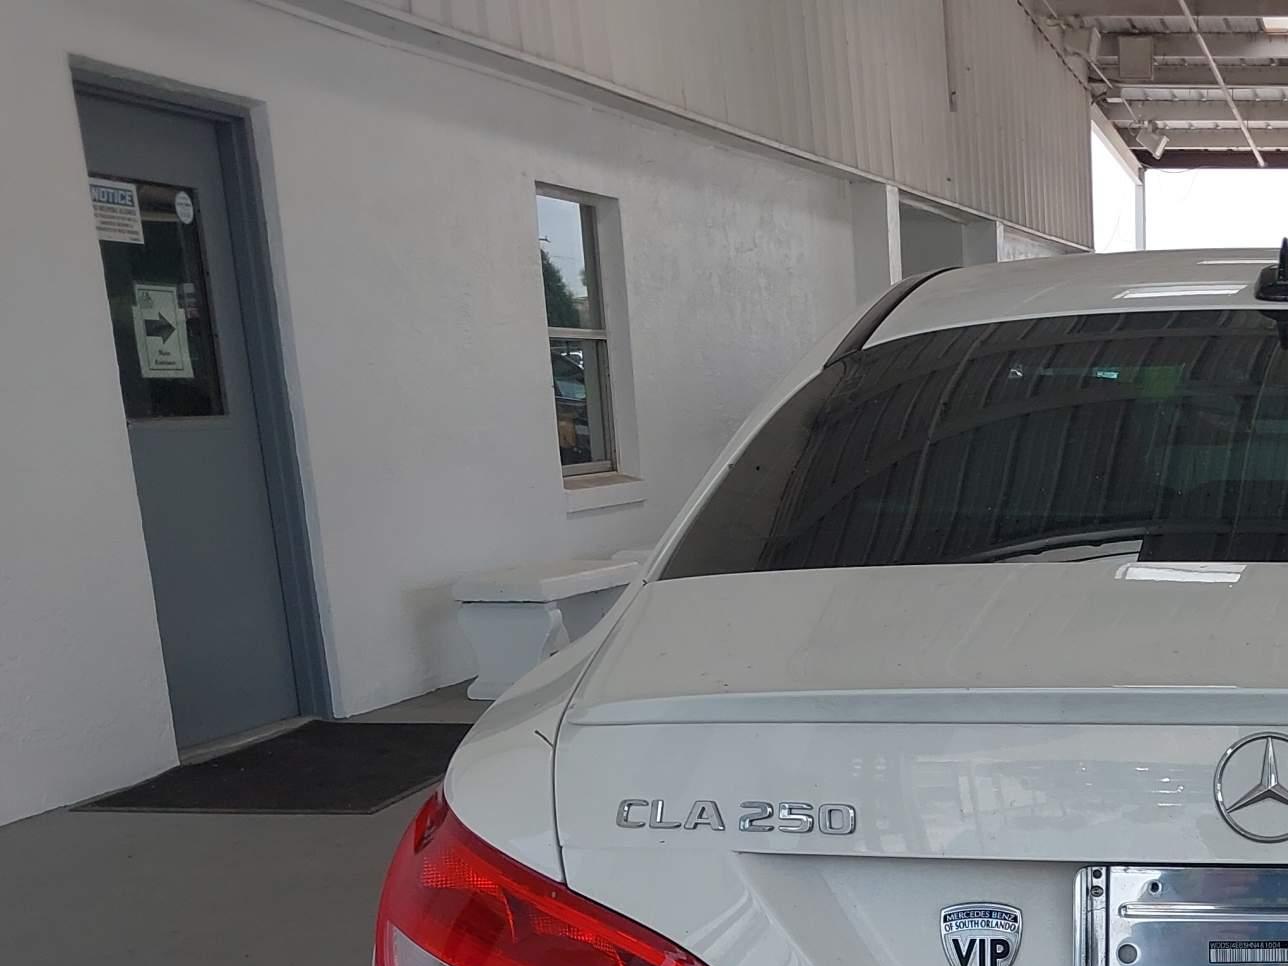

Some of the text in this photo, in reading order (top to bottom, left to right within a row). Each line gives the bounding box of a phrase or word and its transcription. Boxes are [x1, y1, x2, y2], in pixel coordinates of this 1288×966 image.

[91, 187, 133, 205] NOTICE
[616, 798, 857, 835] CLA 250
[955, 919, 979, 930] SOUTH
[980, 919, 1017, 932] ORLANDO
